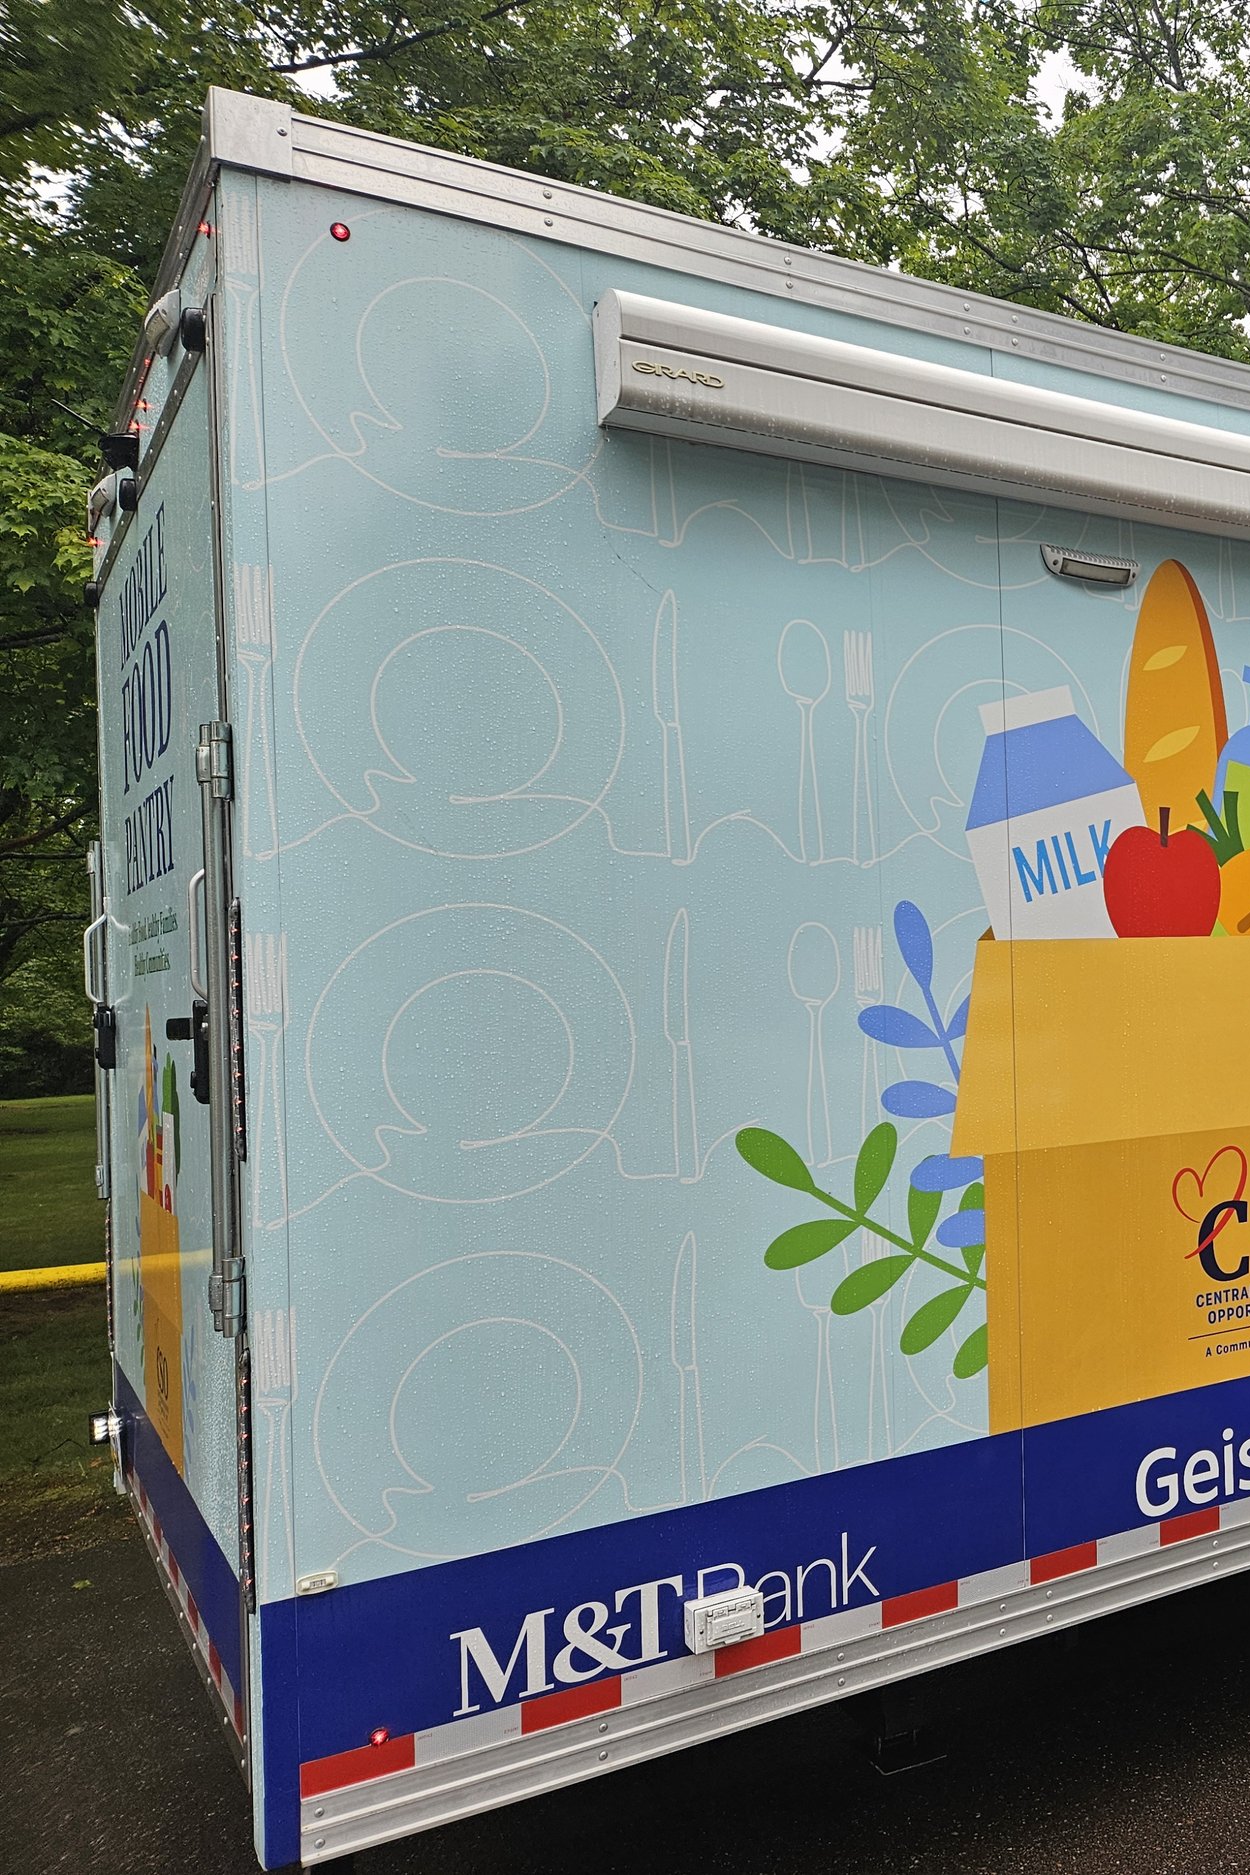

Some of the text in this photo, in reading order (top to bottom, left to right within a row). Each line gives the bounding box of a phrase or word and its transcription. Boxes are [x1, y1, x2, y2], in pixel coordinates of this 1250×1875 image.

[119, 501, 168, 671] MOBILE
[122, 618, 172, 796] FOOD
[125, 775, 175, 896] PANTRY
[1012, 819, 1111, 903] MILK
[1205, 1347, 1212, 1358] A
[450, 1574, 683, 1717] M&T
